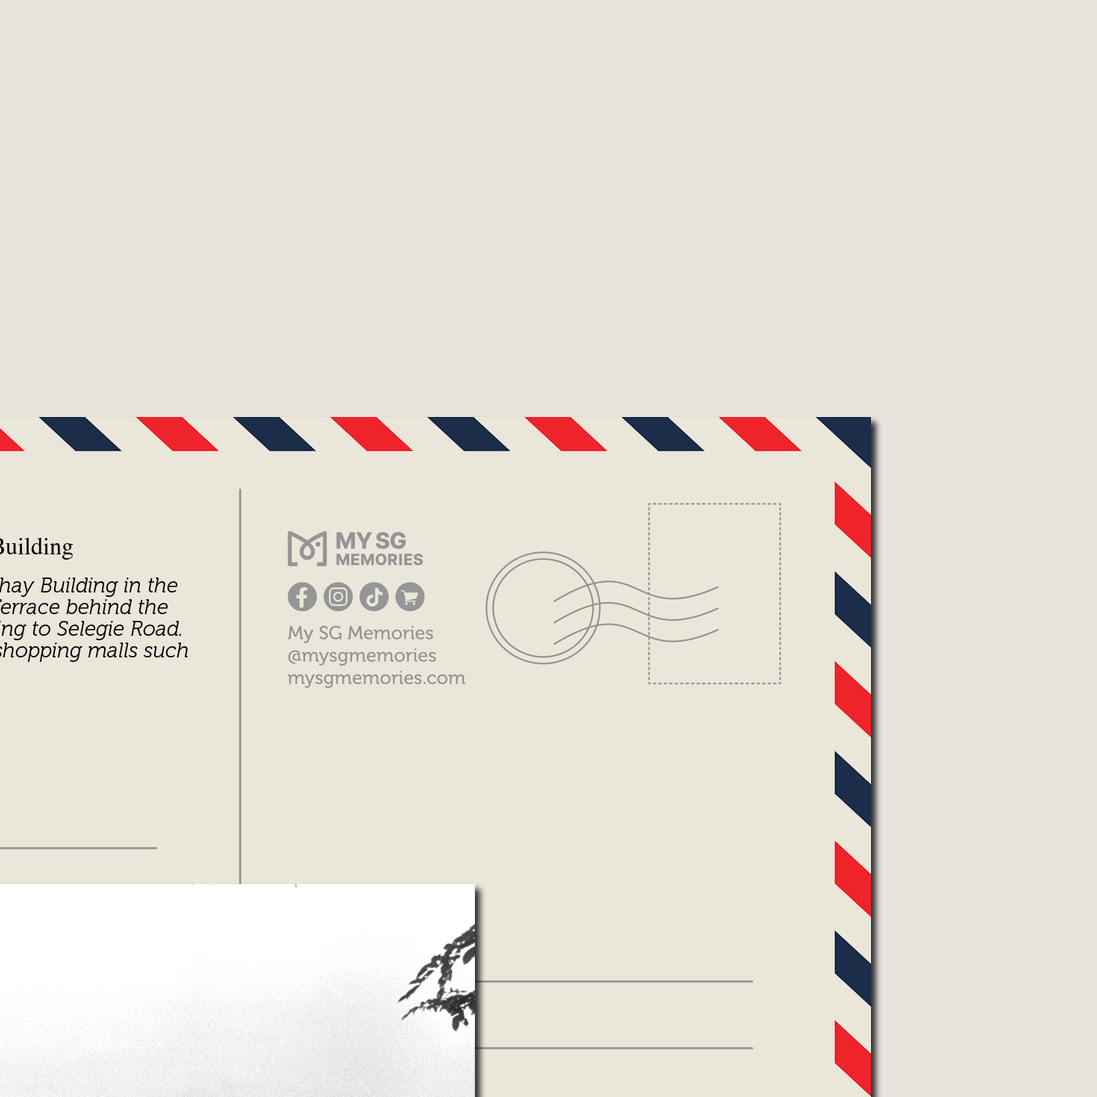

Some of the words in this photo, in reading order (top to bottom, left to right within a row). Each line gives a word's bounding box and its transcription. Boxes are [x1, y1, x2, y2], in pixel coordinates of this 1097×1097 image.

[336, 532, 372, 549] MY
[376, 532, 406, 549] SG
[336, 553, 423, 565] MEMORIES
[41, 577, 118, 597] Building
[124, 577, 140, 593] in
[148, 577, 178, 593] the
[66, 599, 132, 614] behind
[139, 599, 168, 614] the
[33, 621, 51, 636] to
[57, 621, 124, 641] Selegie
[131, 621, 181, 636] Road.
[288, 626, 314, 643] My
[319, 626, 342, 640] SG
[348, 626, 433, 640] Memories
[88, 642, 138, 658] malls
[143, 642, 188, 658] such
[288, 648, 436, 666] @mysgmemories
[288, 671, 465, 688] mysgmemories.com
